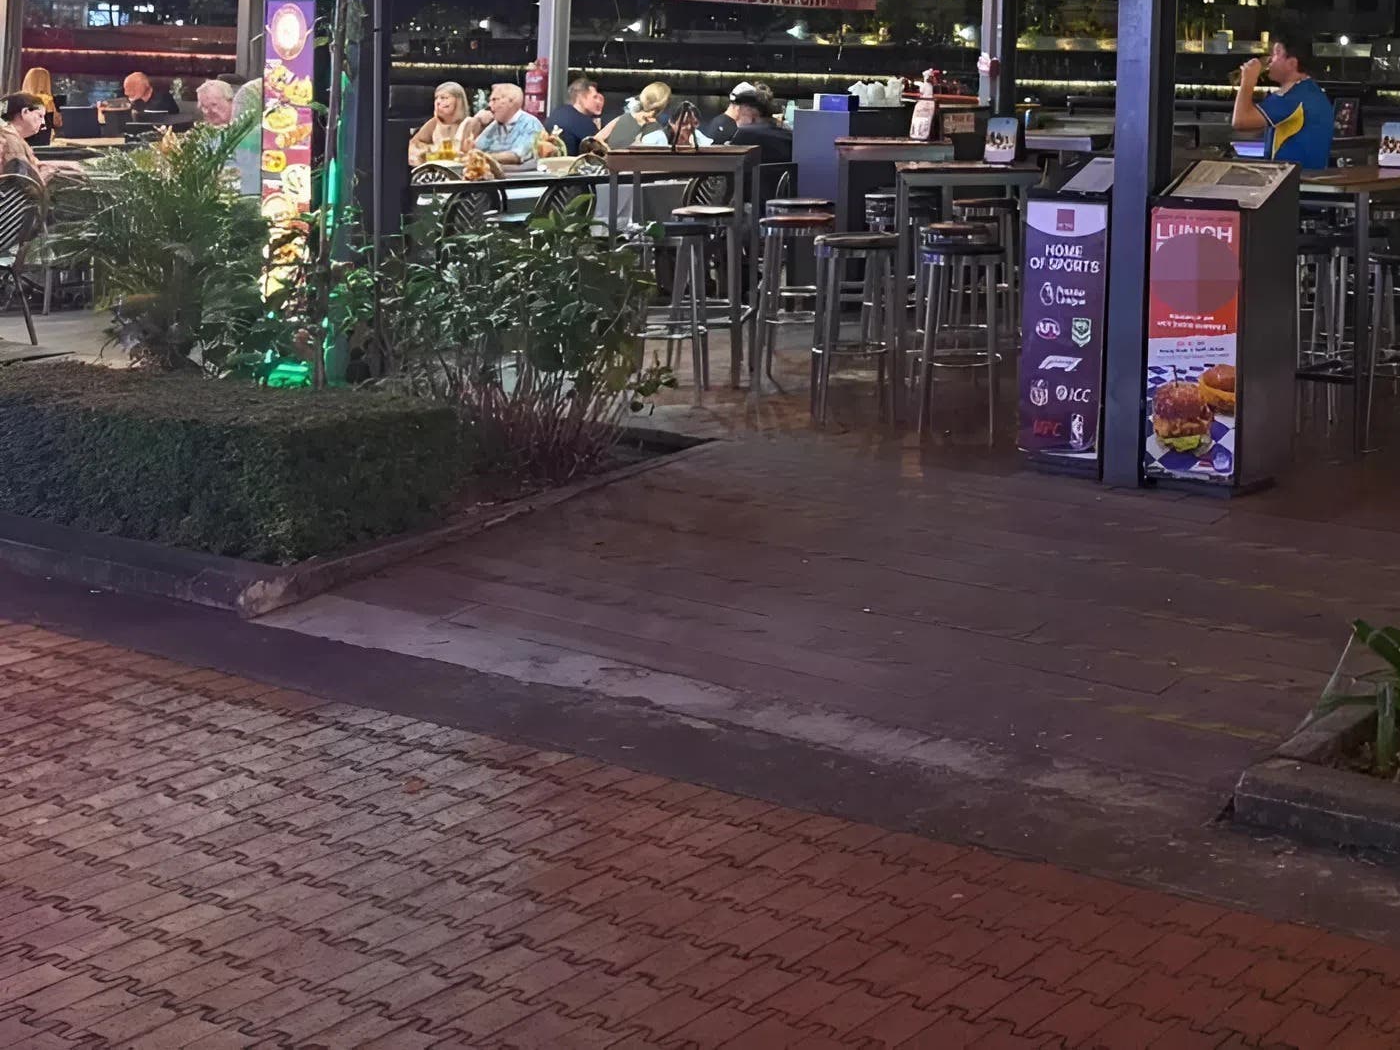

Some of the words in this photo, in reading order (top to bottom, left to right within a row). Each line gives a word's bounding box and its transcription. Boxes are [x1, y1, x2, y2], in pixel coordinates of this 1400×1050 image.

[1045, 244, 1083, 257] HOME
[1048, 258, 1100, 273] SPORTS
[1068, 388, 1091, 403] ICC
